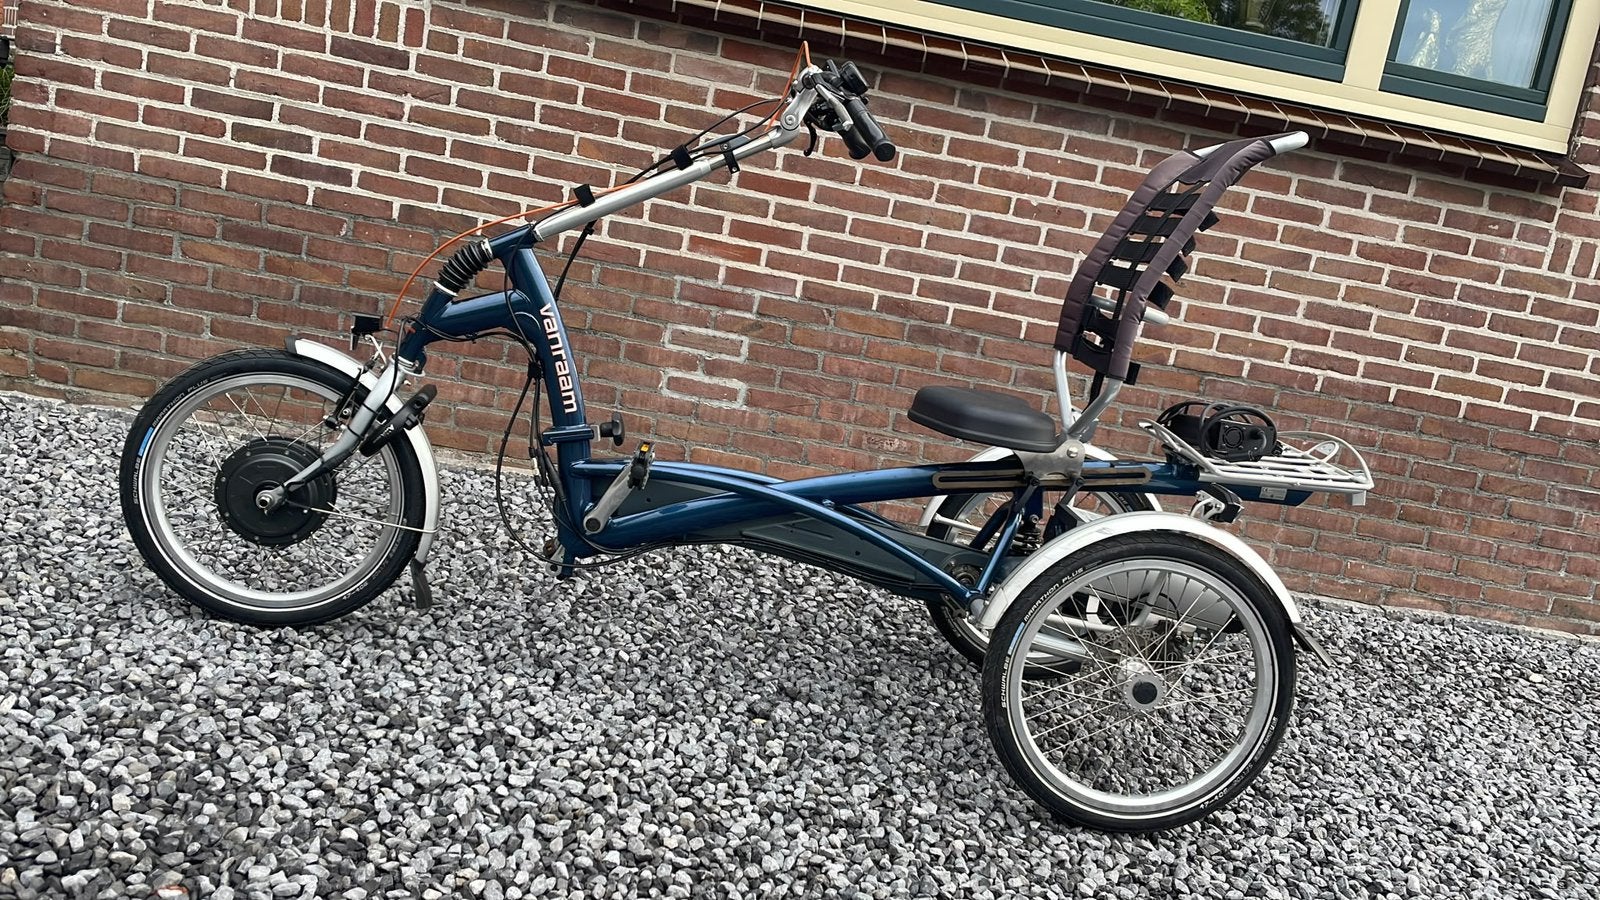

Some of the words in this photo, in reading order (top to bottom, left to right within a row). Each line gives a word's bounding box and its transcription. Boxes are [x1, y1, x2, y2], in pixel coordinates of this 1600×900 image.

[540, 303, 578, 413] vanraam
[133, 457, 141, 505] SCHWALBE
[187, 379, 209, 392] PLUS
[1001, 656, 1010, 708] SCHWALBE
[1023, 583, 1060, 622] MARATHON
[1061, 567, 1084, 584] PLUS
